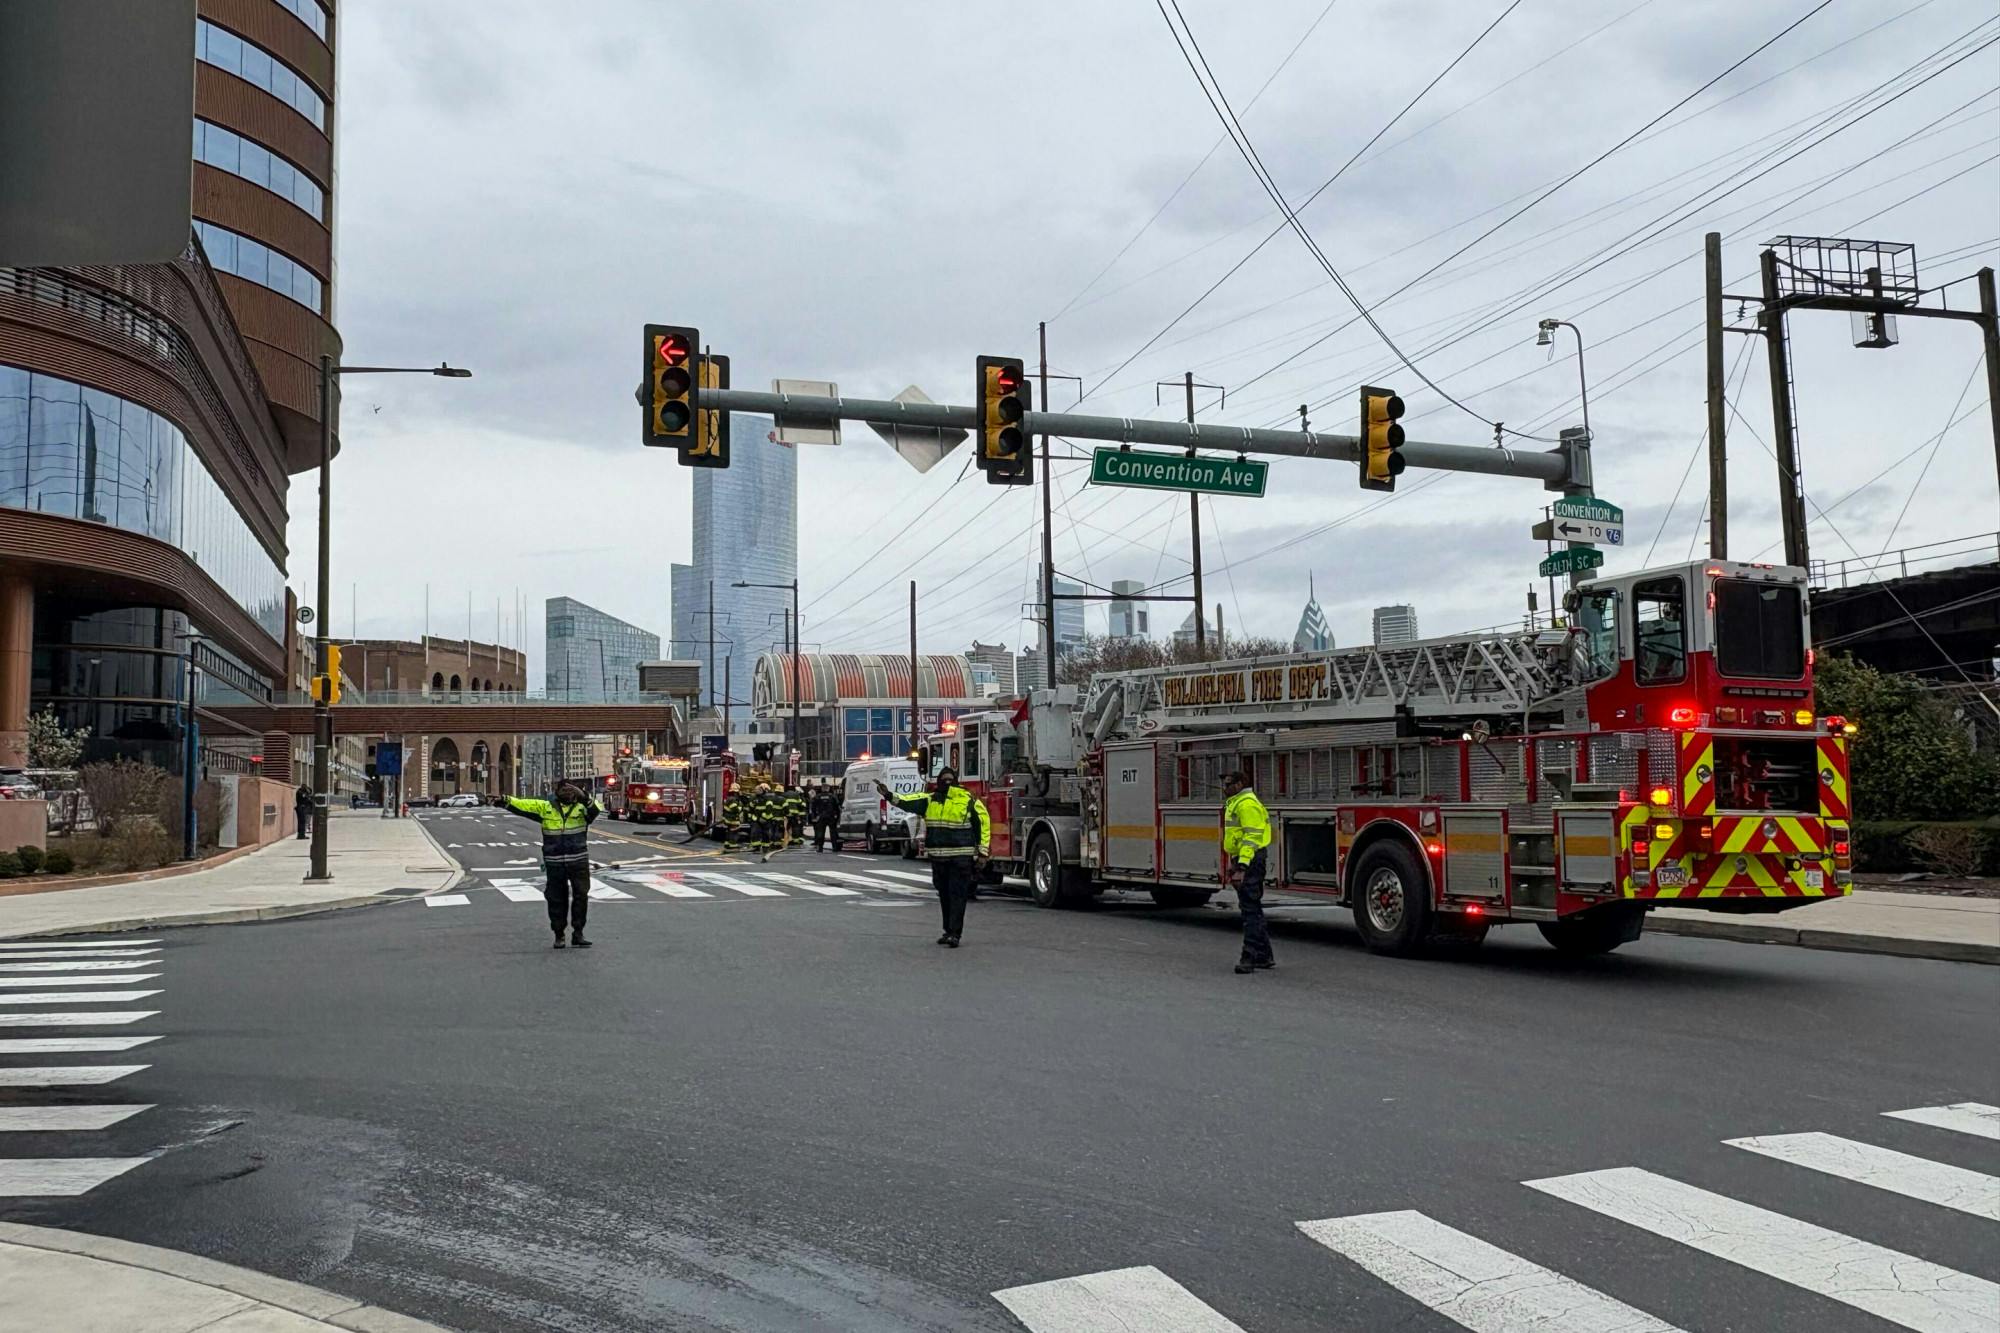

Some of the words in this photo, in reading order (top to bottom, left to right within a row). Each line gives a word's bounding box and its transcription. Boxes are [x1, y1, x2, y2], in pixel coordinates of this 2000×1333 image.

[1105, 456, 1214, 484] Convention
[1219, 466, 1254, 487] Ave
[1556, 503, 1610, 521] CONVENTION
[1588, 527, 1601, 537] TO
[1608, 529, 1619, 540] 76
[1540, 559, 1572, 576] HEALTH
[1577, 555, 1588, 569] SC
[1164, 673, 1246, 706] PHILADELPHIA
[1251, 668, 1283, 701] FIRE
[1289, 665, 1329, 700] DEPT.
[1122, 769, 1138, 783] RIT
[895, 782, 924, 793] POLI
[1488, 876, 1498, 888] 11
